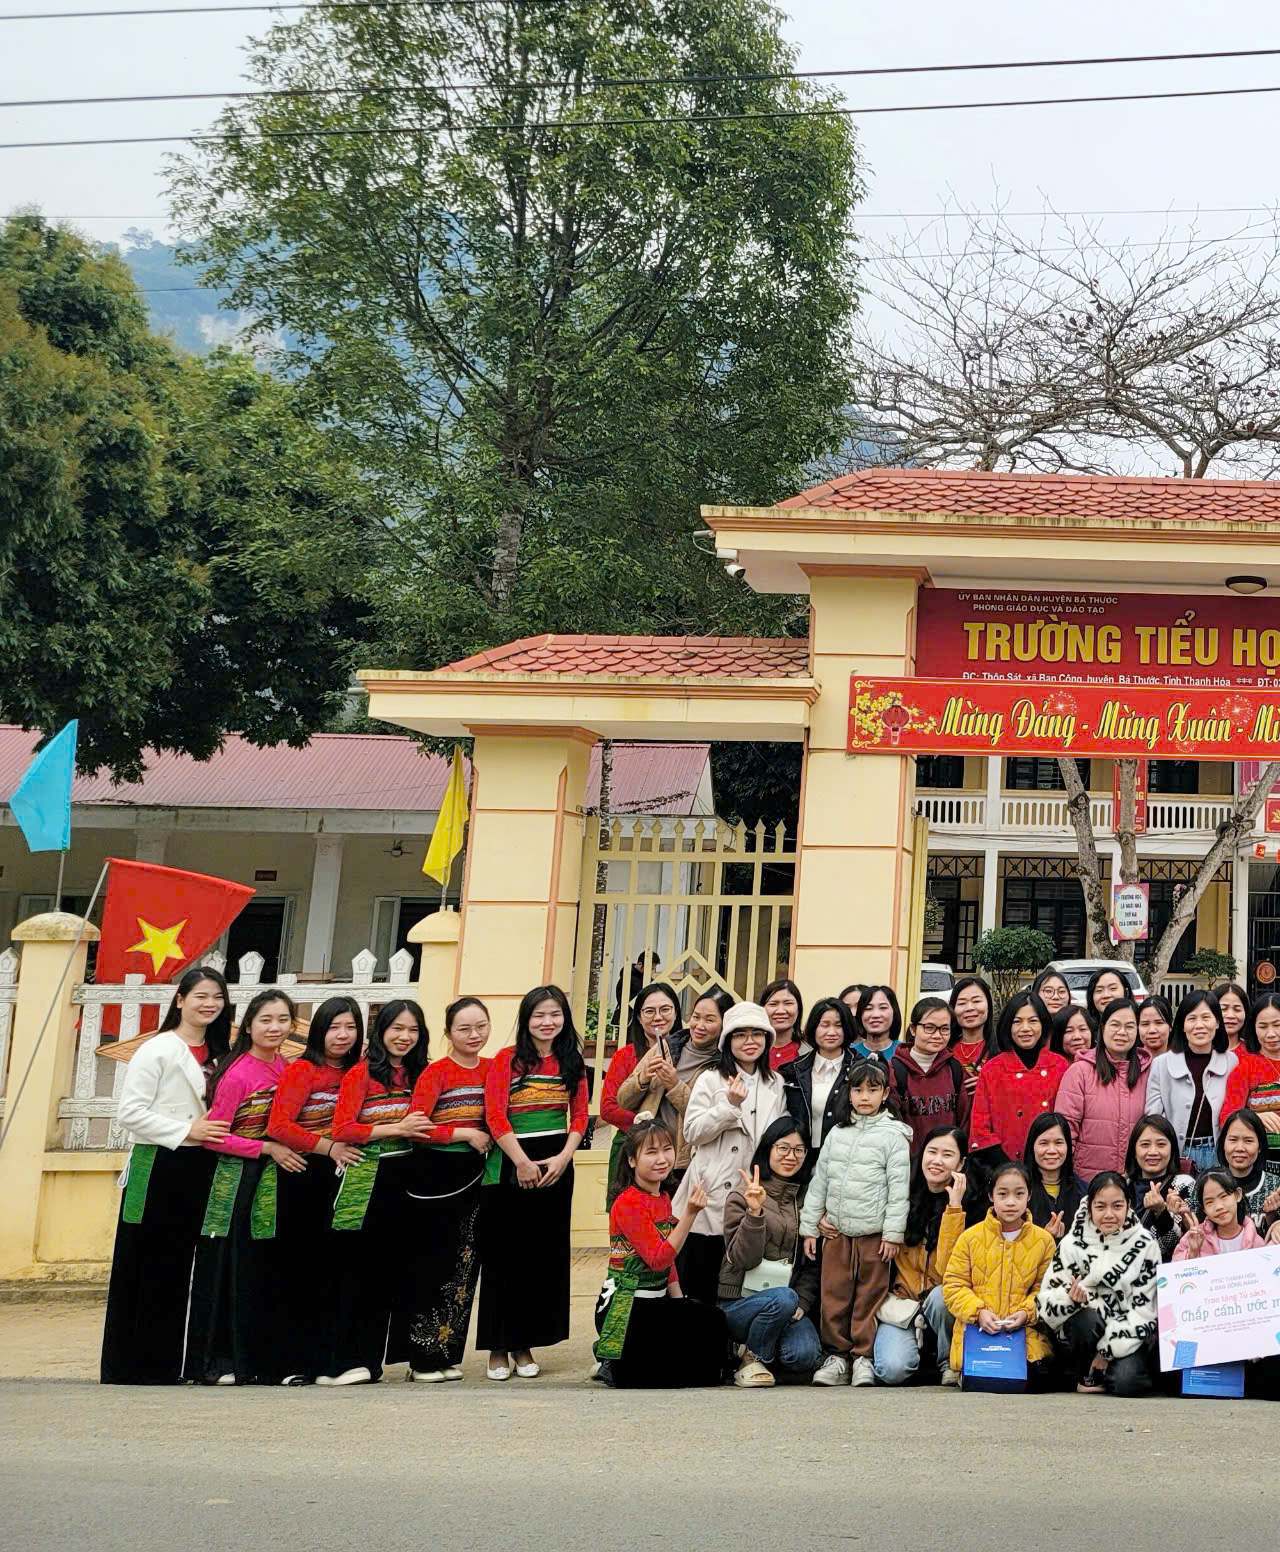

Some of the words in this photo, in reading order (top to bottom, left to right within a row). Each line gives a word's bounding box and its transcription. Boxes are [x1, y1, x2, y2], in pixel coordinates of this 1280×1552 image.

[994, 592, 1018, 602] NHÂN
[1021, 594, 1040, 603] DÂN
[1074, 595, 1086, 604] BÁ
[973, 602, 1004, 612] PHÒNG
[1006, 604, 1028, 612] GIÁO
[1030, 605, 1048, 614] DỤC
[1051, 604, 1064, 613] VÀ
[1088, 606, 1104, 615] TẠO
[963, 614, 1122, 664] TRƯỜNG
[1134, 610, 1218, 666] TIỂU
[1184, 676, 1210, 686] Thanh
[1214, 676, 1230, 686] Hóa
[936, 696, 1004, 746] Mừng
[1010, 698, 1077, 748] Đảng
[1092, 700, 1161, 750] Mừng
[1167, 702, 1232, 743] Xuân
[1214, 1303, 1242, 1318] cánh
